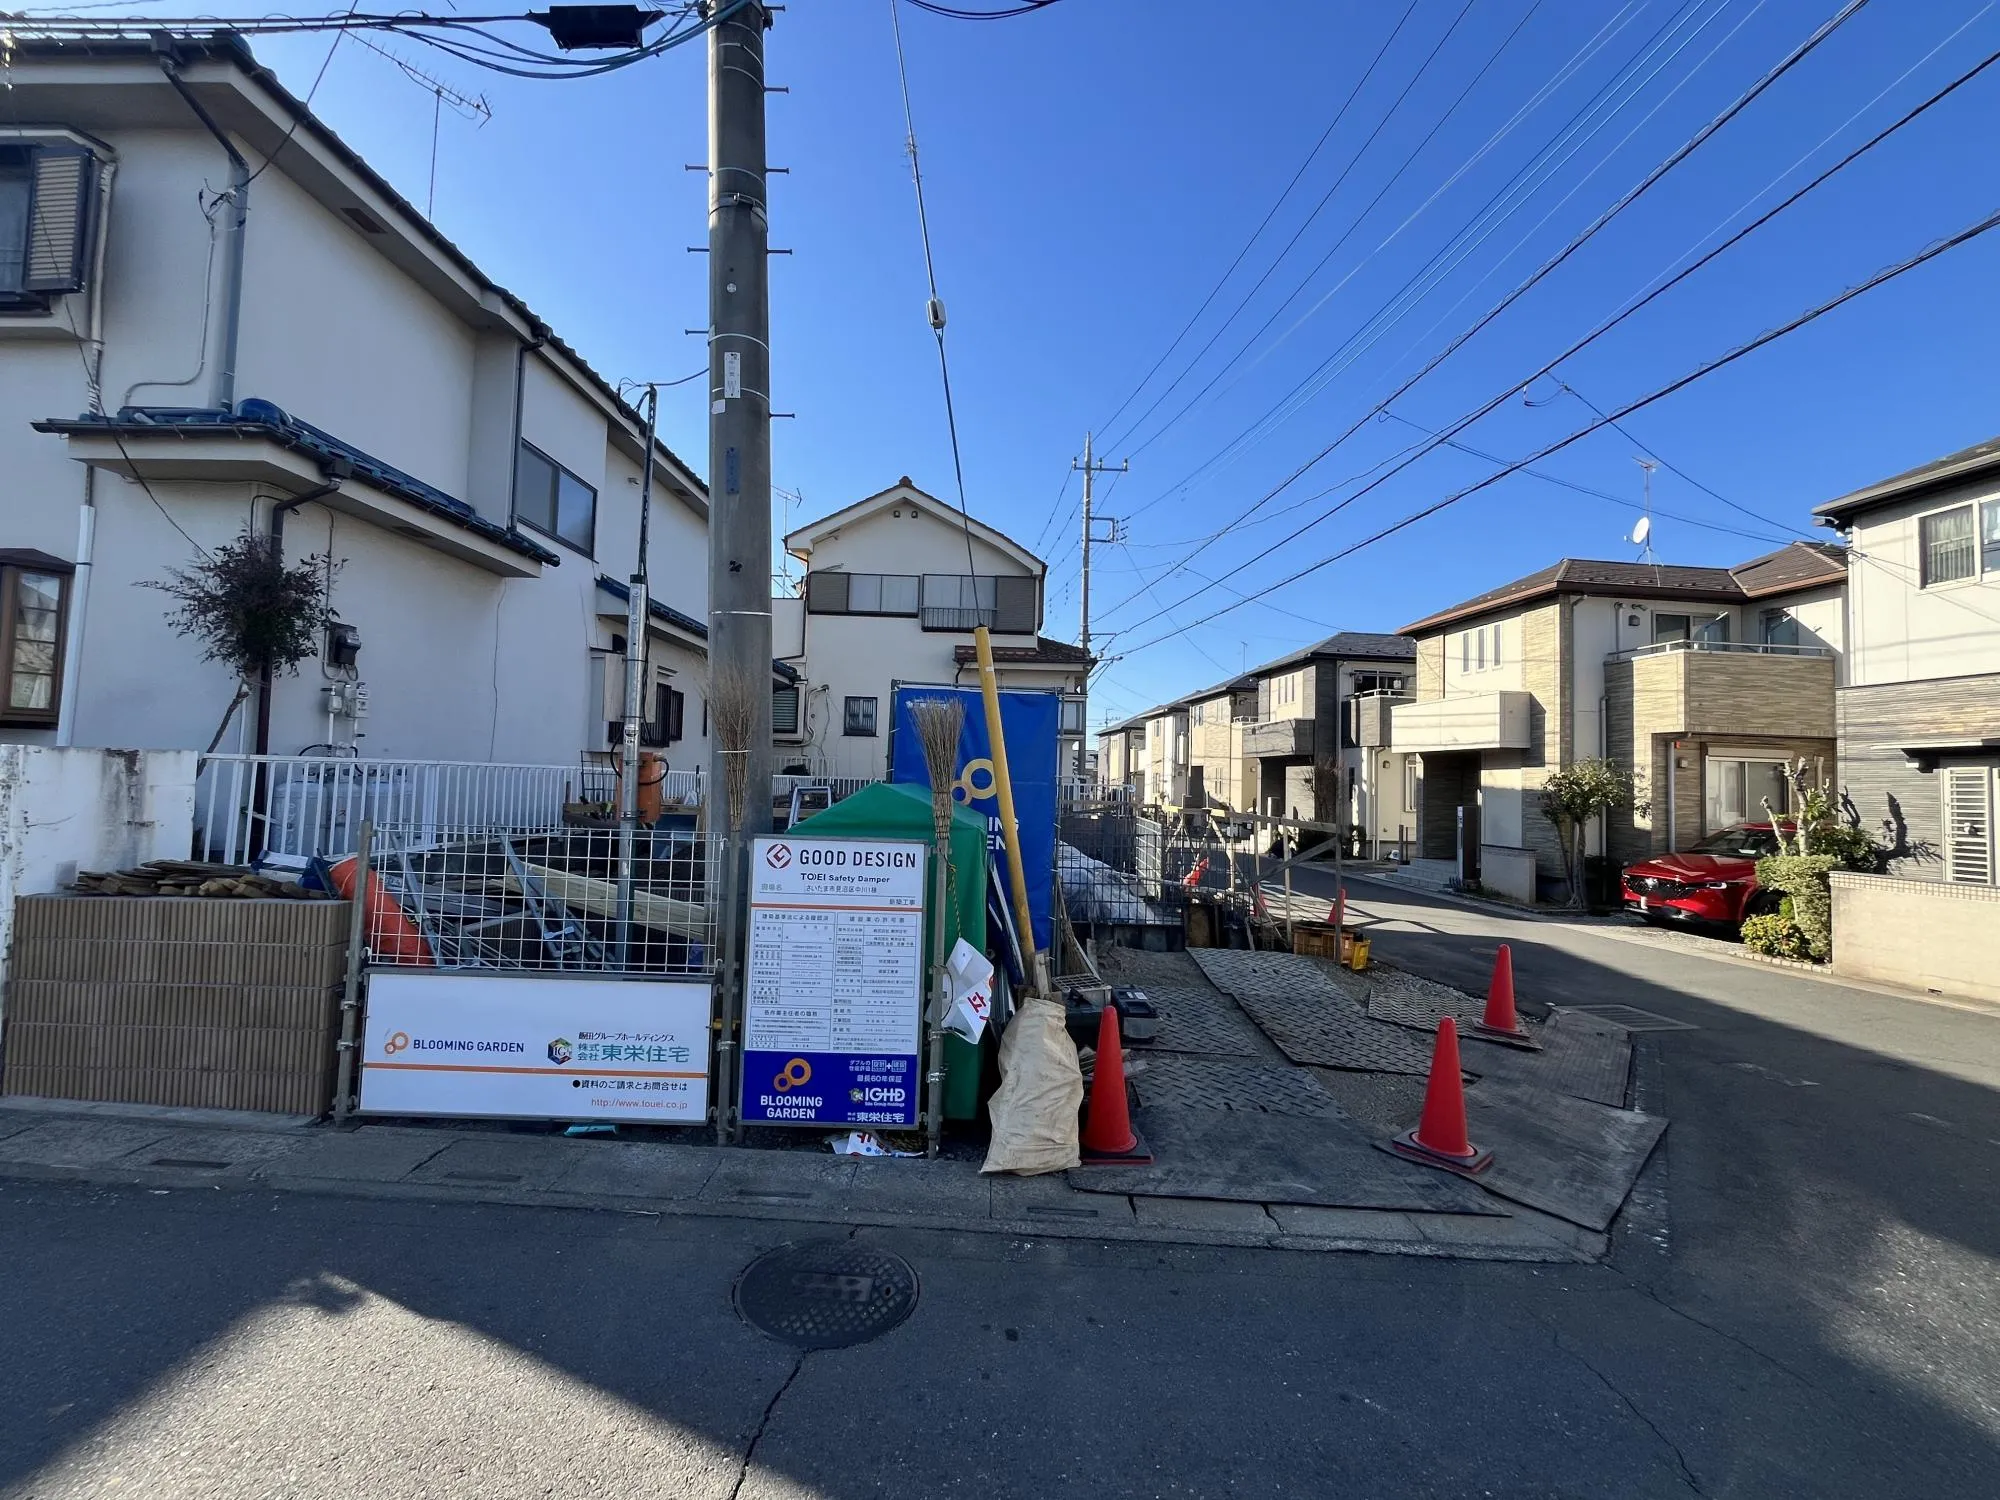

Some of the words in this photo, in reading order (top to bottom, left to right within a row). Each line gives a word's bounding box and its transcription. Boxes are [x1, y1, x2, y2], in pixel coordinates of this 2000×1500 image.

[799, 849, 847, 867] GOOD
[853, 851, 916, 868] DESIGN
[828, 874, 855, 884] Safety
[857, 875, 890, 884] Damper
[578, 1031, 675, 1042] 飯田グループホールディングス
[413, 1039, 474, 1051] BLOOMING
[476, 1041, 525, 1053] GARDEN
[577, 1043, 600, 1052] 株式
[577, 1052, 600, 1061] 会社
[600, 1044, 690, 1063] 東栄住宅
[581, 1079, 688, 1092] 資料のご請求とお問合せは
[591, 1098, 688, 1110] http://www.touei.co.jp
[760, 1095, 823, 1108] BLOOMING
[766, 1107, 816, 1119] GARDEN
[856, 1111, 905, 1123] 東栄住宅
